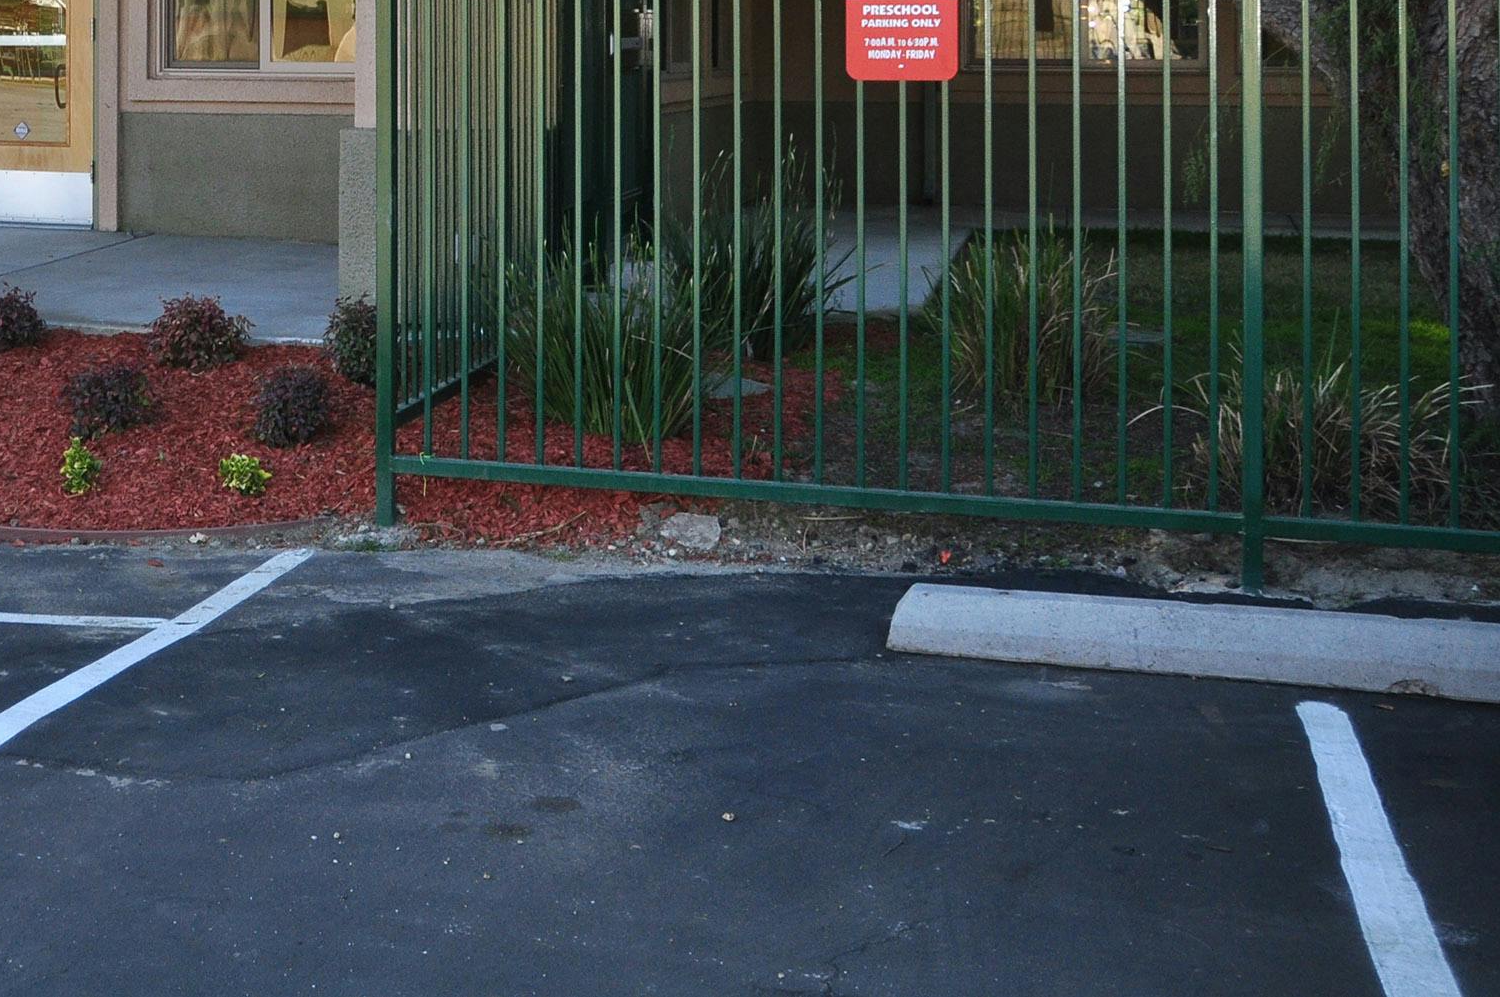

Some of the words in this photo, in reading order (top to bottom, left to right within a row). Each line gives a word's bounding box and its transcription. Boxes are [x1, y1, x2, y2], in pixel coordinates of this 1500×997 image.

[862, 4, 939, 15] PRESCHOOL
[861, 18, 909, 28] PARKING
[911, 18, 941, 28] ONLY
